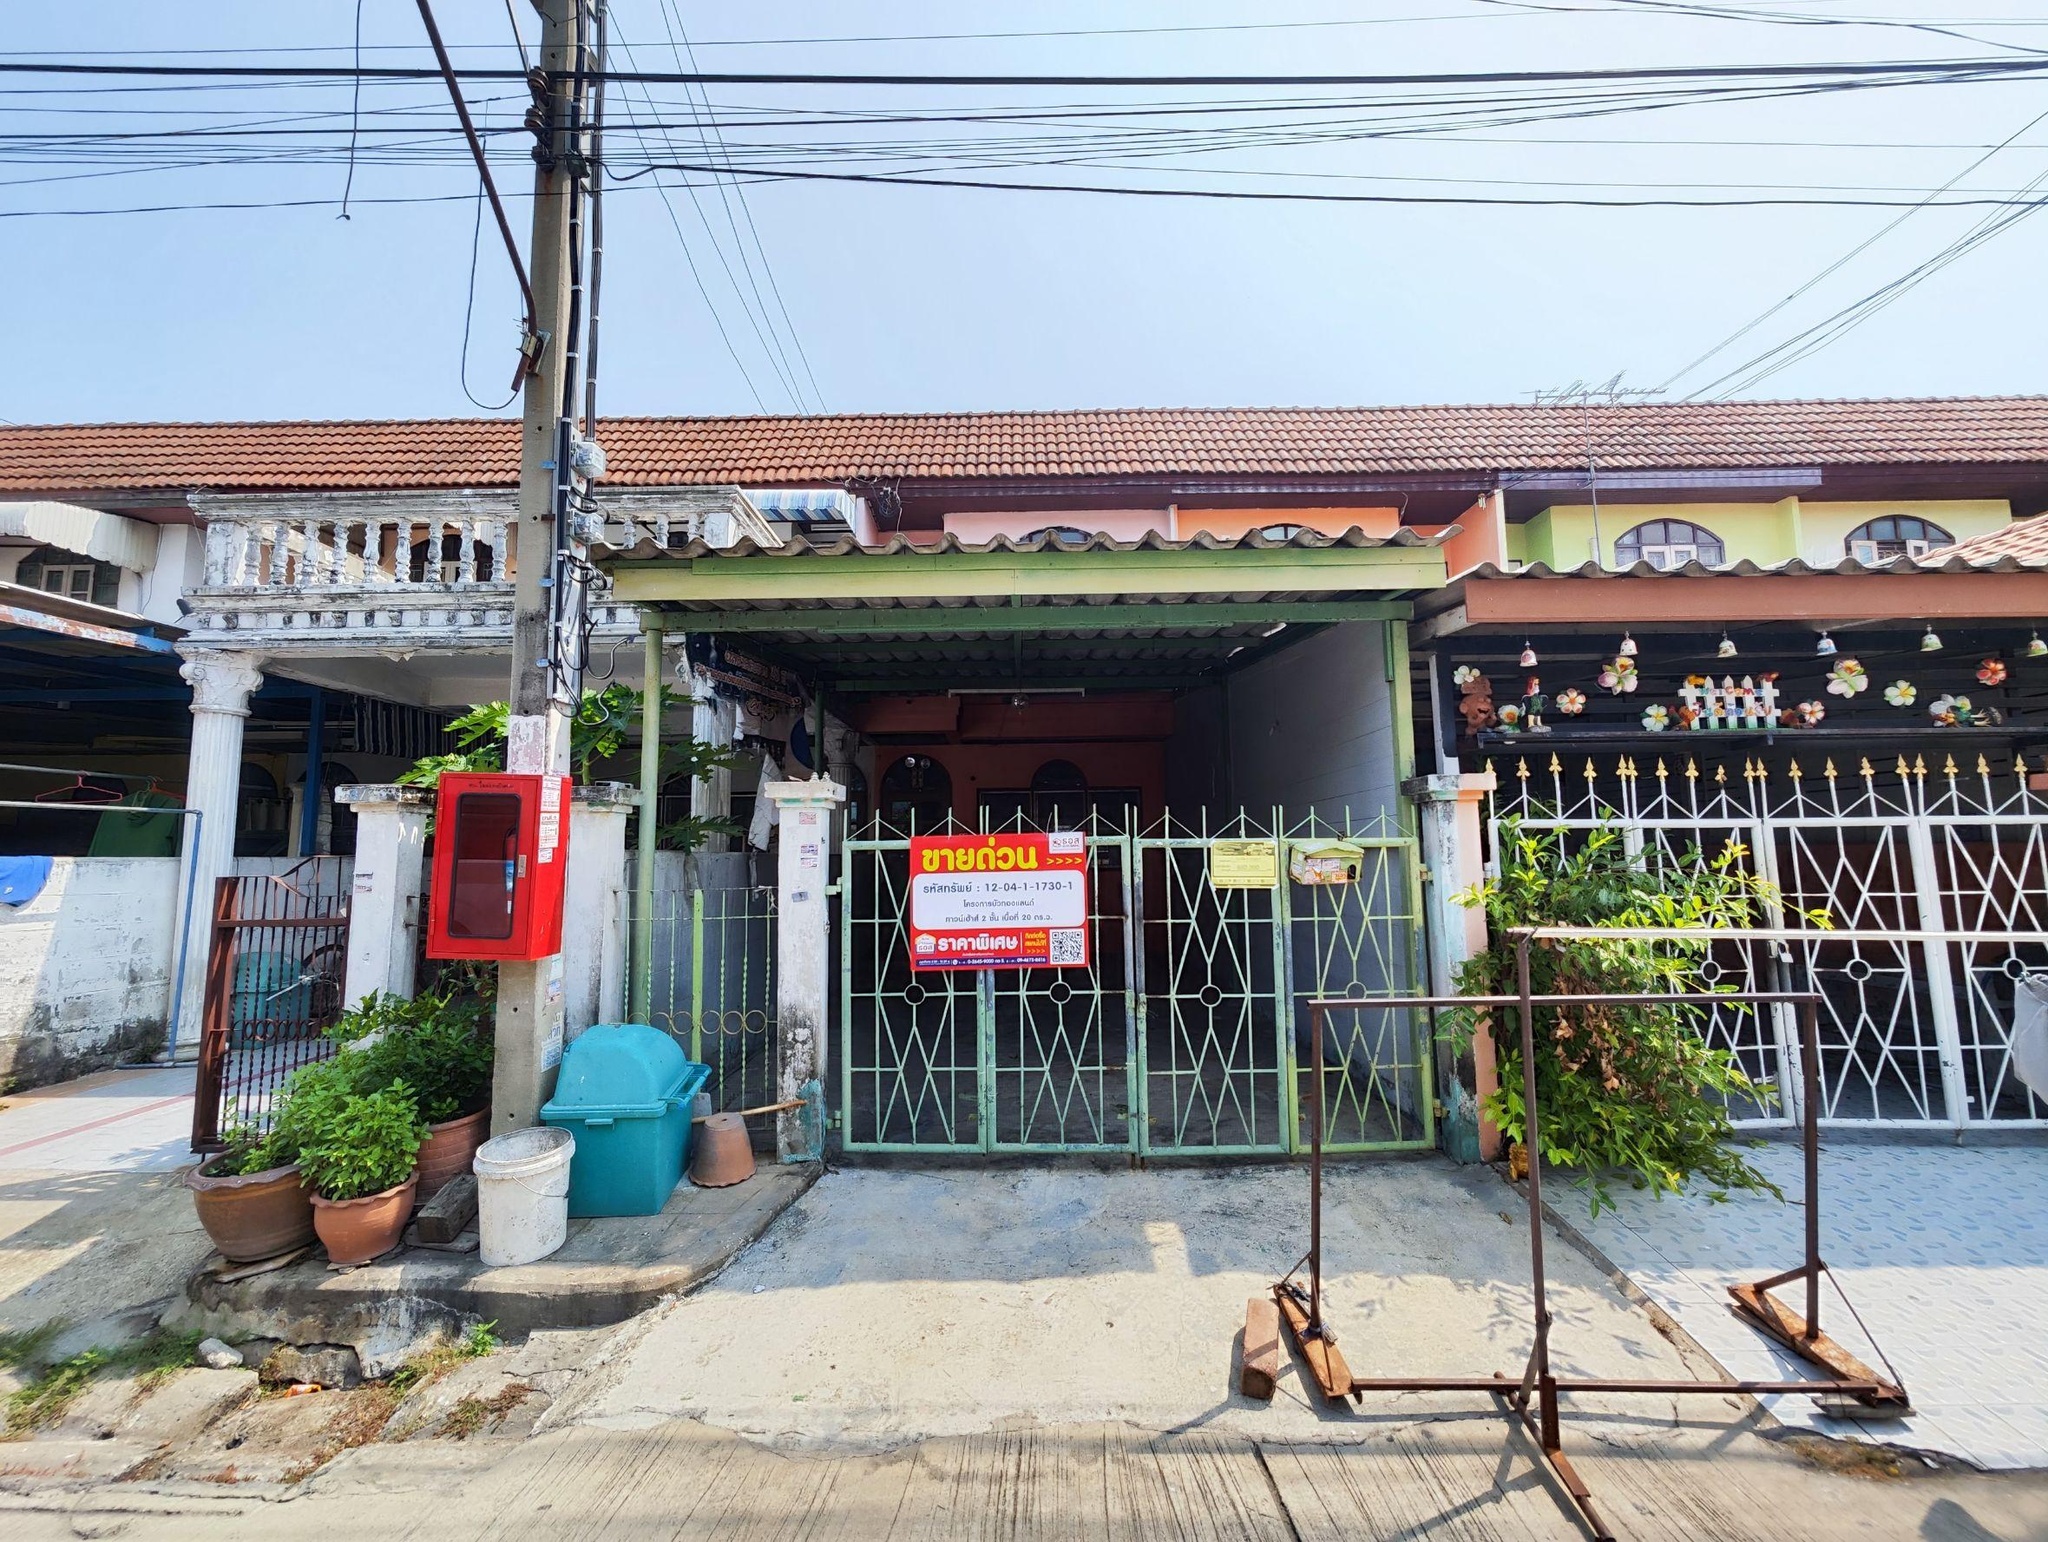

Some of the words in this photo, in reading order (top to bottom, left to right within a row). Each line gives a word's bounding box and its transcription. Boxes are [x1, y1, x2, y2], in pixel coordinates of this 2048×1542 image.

[921, 837, 1039, 872] ขายด่วน
[922, 881, 973, 894] รหัสทรัพย์
[984, 881, 1073, 893] 12-04-1-1730-1
[962, 898, 1035, 908] โครงการบัวทองแลนด์
[981, 914, 987, 922] 2
[989, 911, 999, 922] ชั้น
[1001, 911, 1019, 922] เนื้อที่
[1021, 913, 1032, 921] 20
[937, 933, 1019, 952] ราคาพิเศษ
